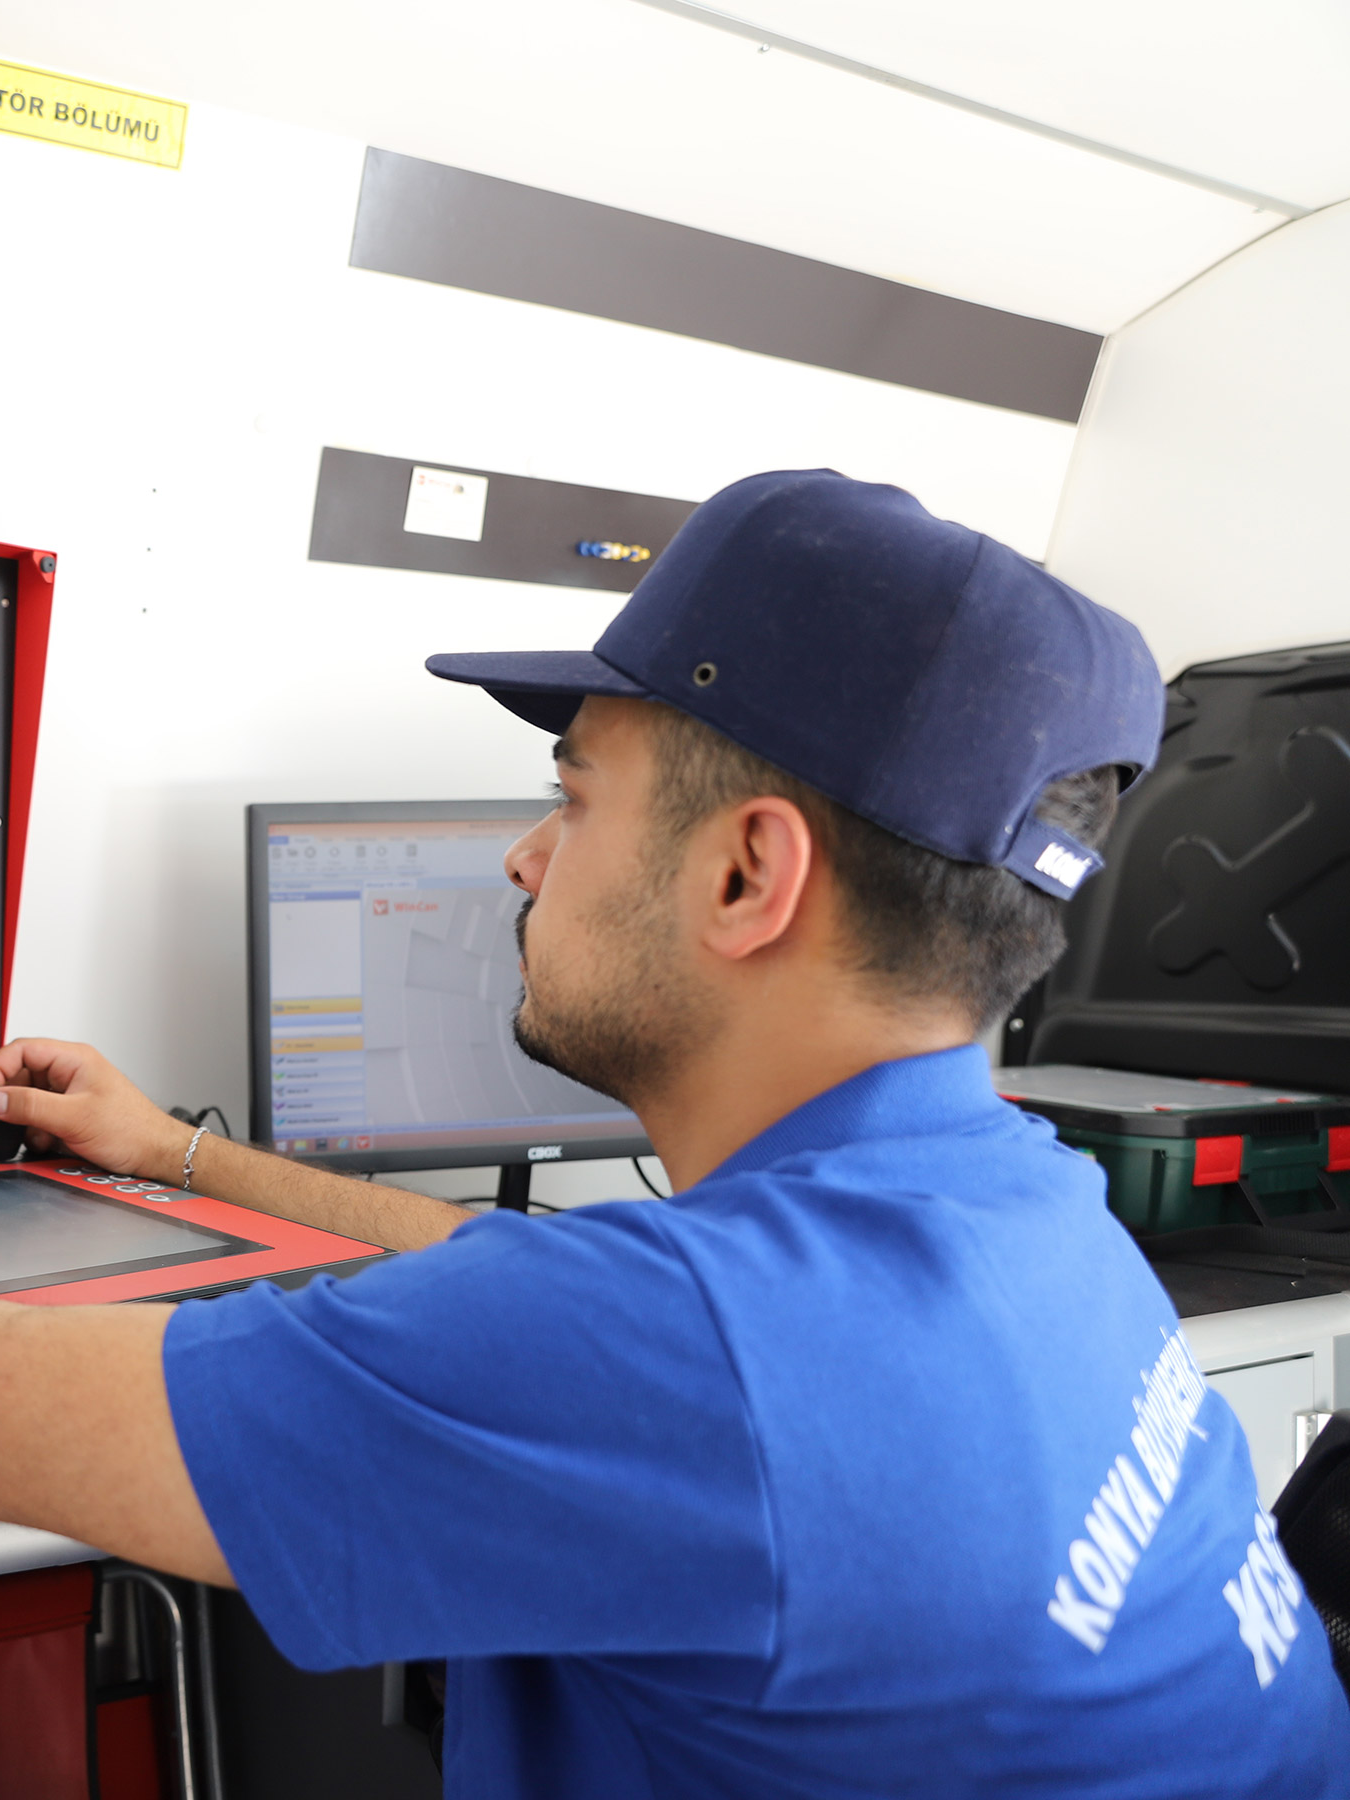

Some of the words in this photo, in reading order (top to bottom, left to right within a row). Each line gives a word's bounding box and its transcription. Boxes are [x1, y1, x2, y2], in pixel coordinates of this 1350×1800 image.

[54, 101, 159, 142] BÖLÜMÜ
[1047, 1454, 1166, 1655] KONYA
[1222, 1496, 1301, 1691] KOS
